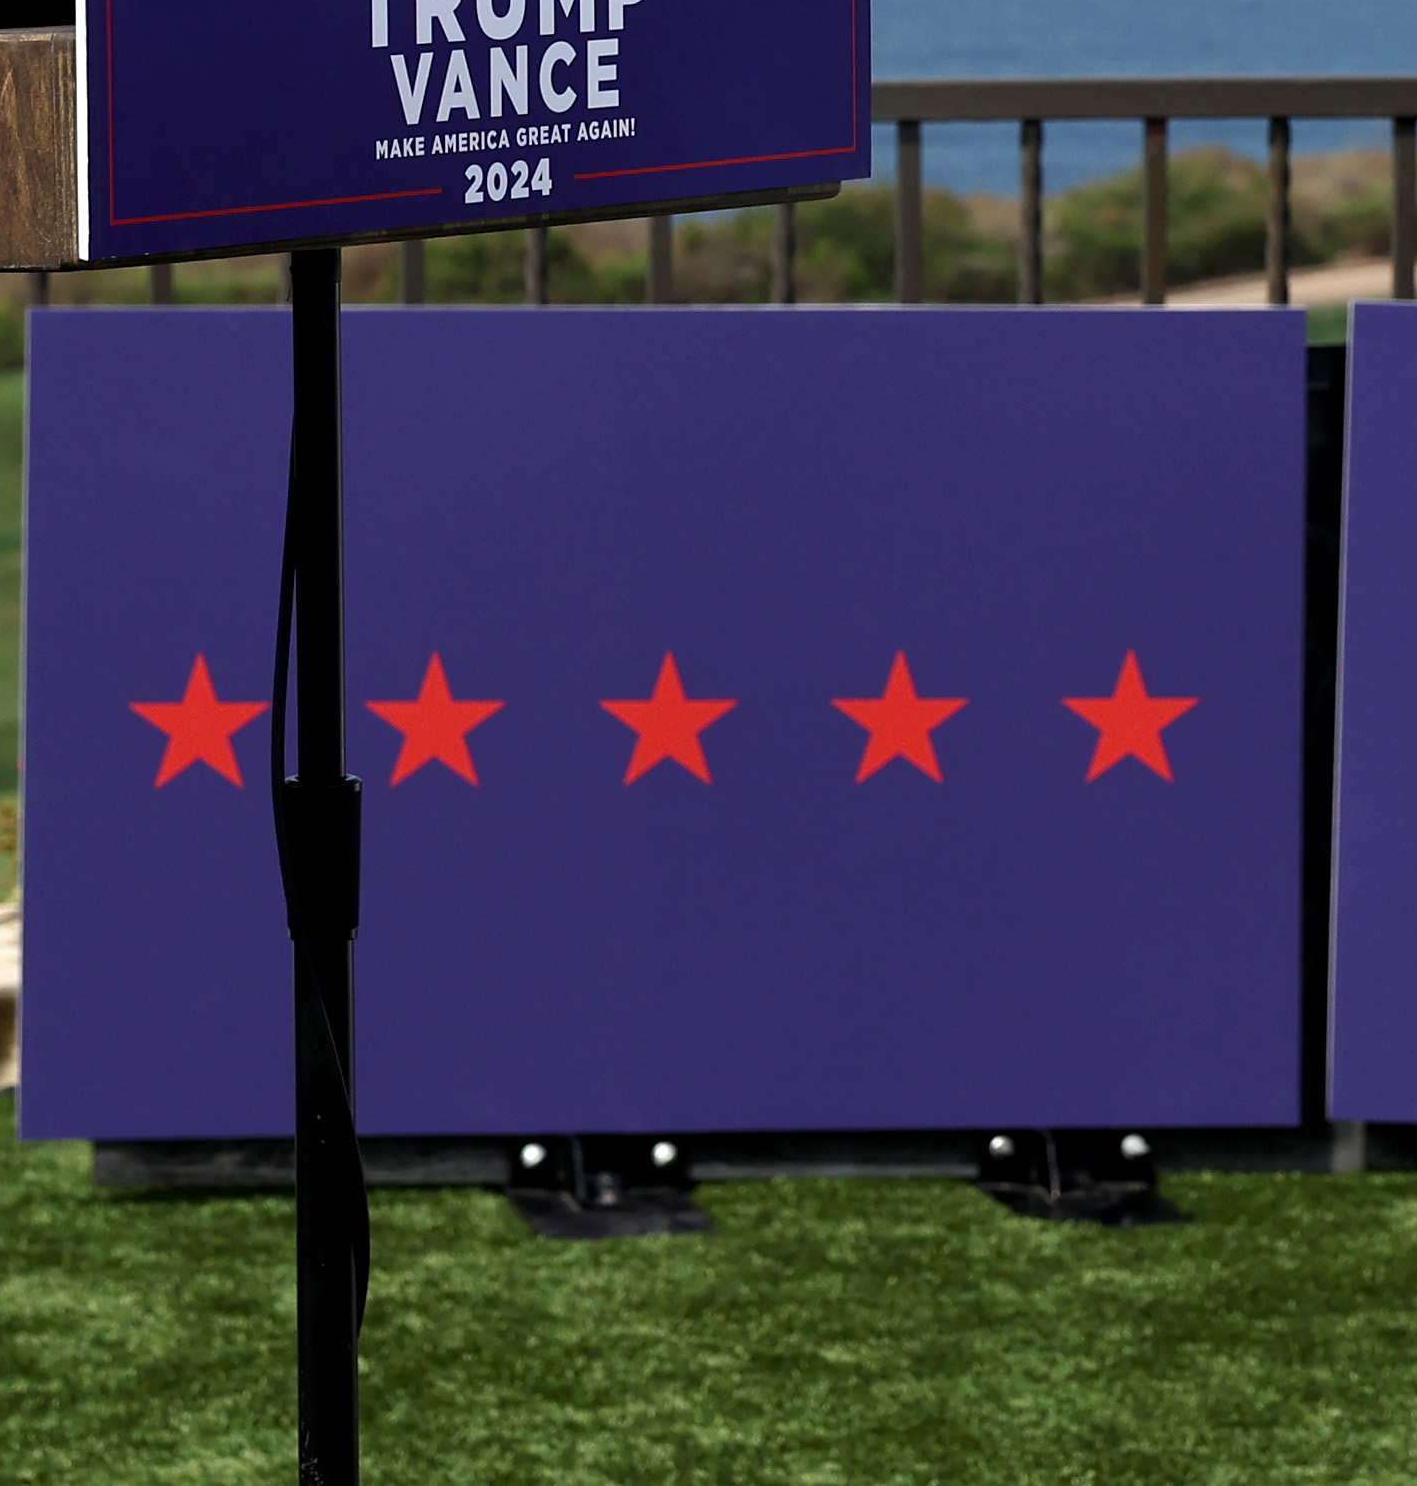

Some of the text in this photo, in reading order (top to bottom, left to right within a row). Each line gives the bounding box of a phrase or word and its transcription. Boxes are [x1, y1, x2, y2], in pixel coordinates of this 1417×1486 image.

[390, 37, 620, 126] VANCE
[375, 117, 637, 160] MAKE AMERICA GREAT AGAIN!
[464, 157, 553, 204] 2024
